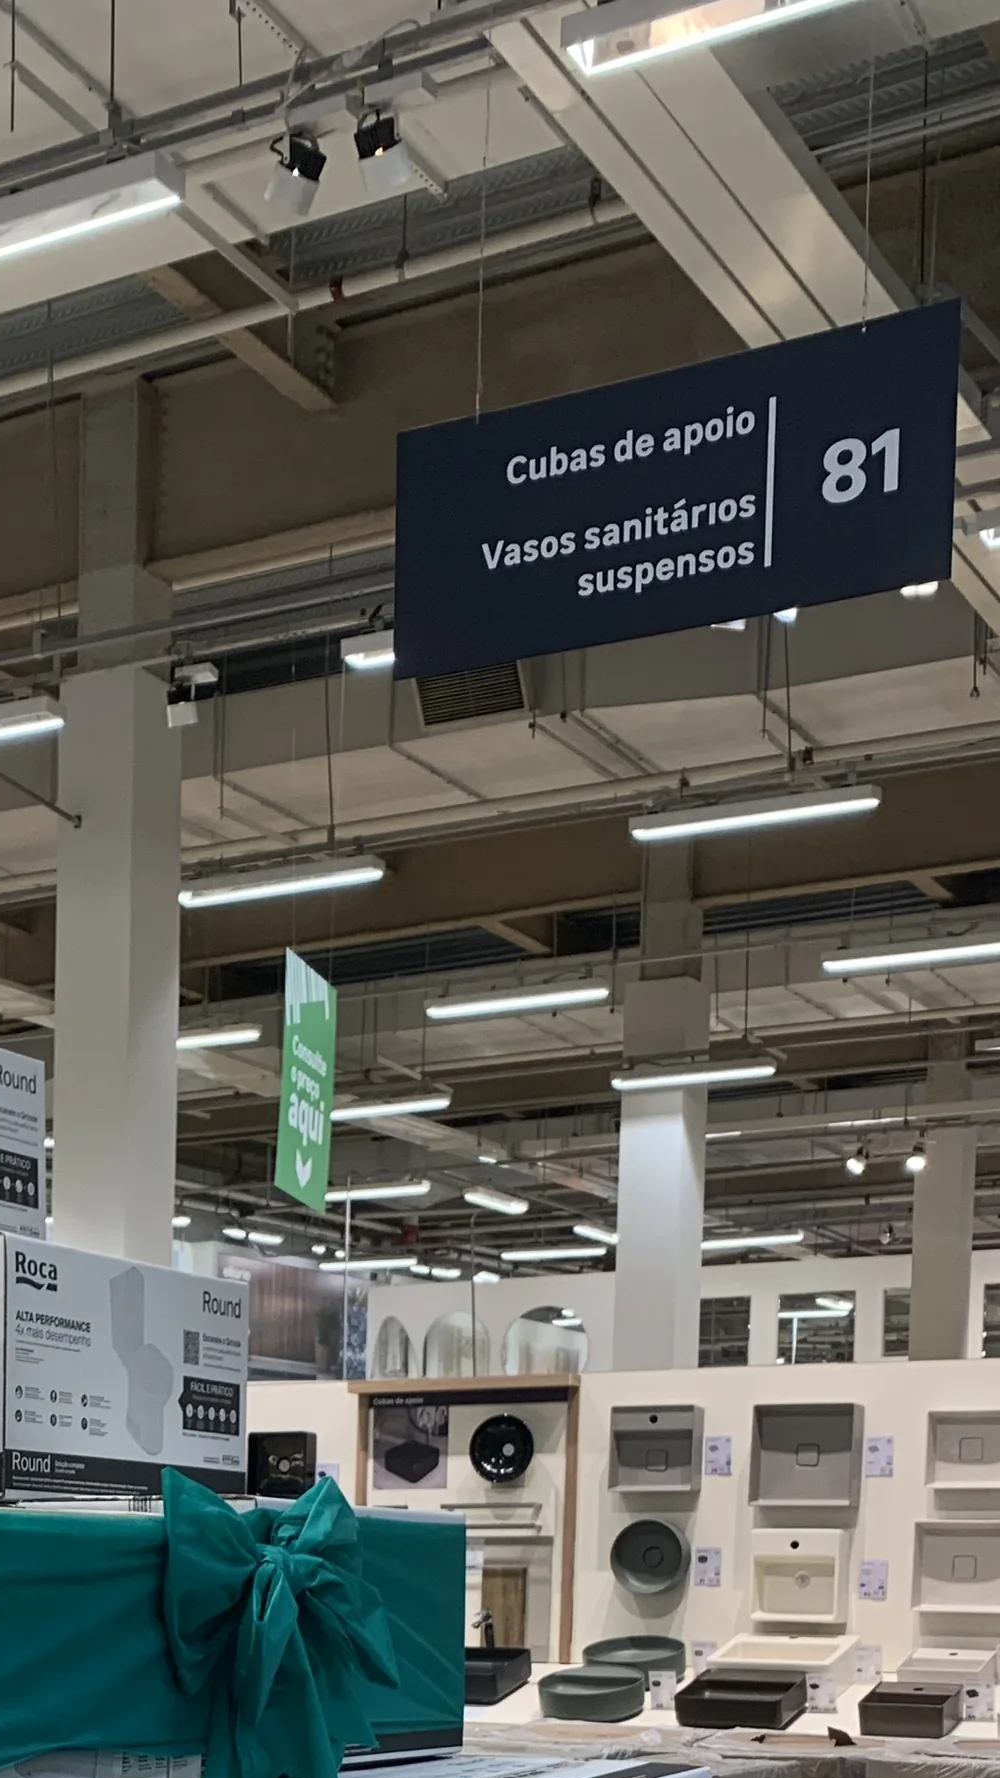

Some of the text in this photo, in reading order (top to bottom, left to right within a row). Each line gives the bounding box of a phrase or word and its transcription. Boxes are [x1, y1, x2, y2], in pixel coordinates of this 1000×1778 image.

[506, 406, 756, 485] Cubas de apoio
[821, 428, 901, 504] 81
[482, 493, 757, 570] Vasos sanitários
[577, 540, 756, 597] suspensos
[288, 1091, 325, 1147] aqui
[15, 1251, 58, 1282] Roca
[15, 1310, 91, 1333] ALTA PERFORMANCE
[202, 1290, 242, 1319] Round
[12, 1451, 51, 1473] Round
